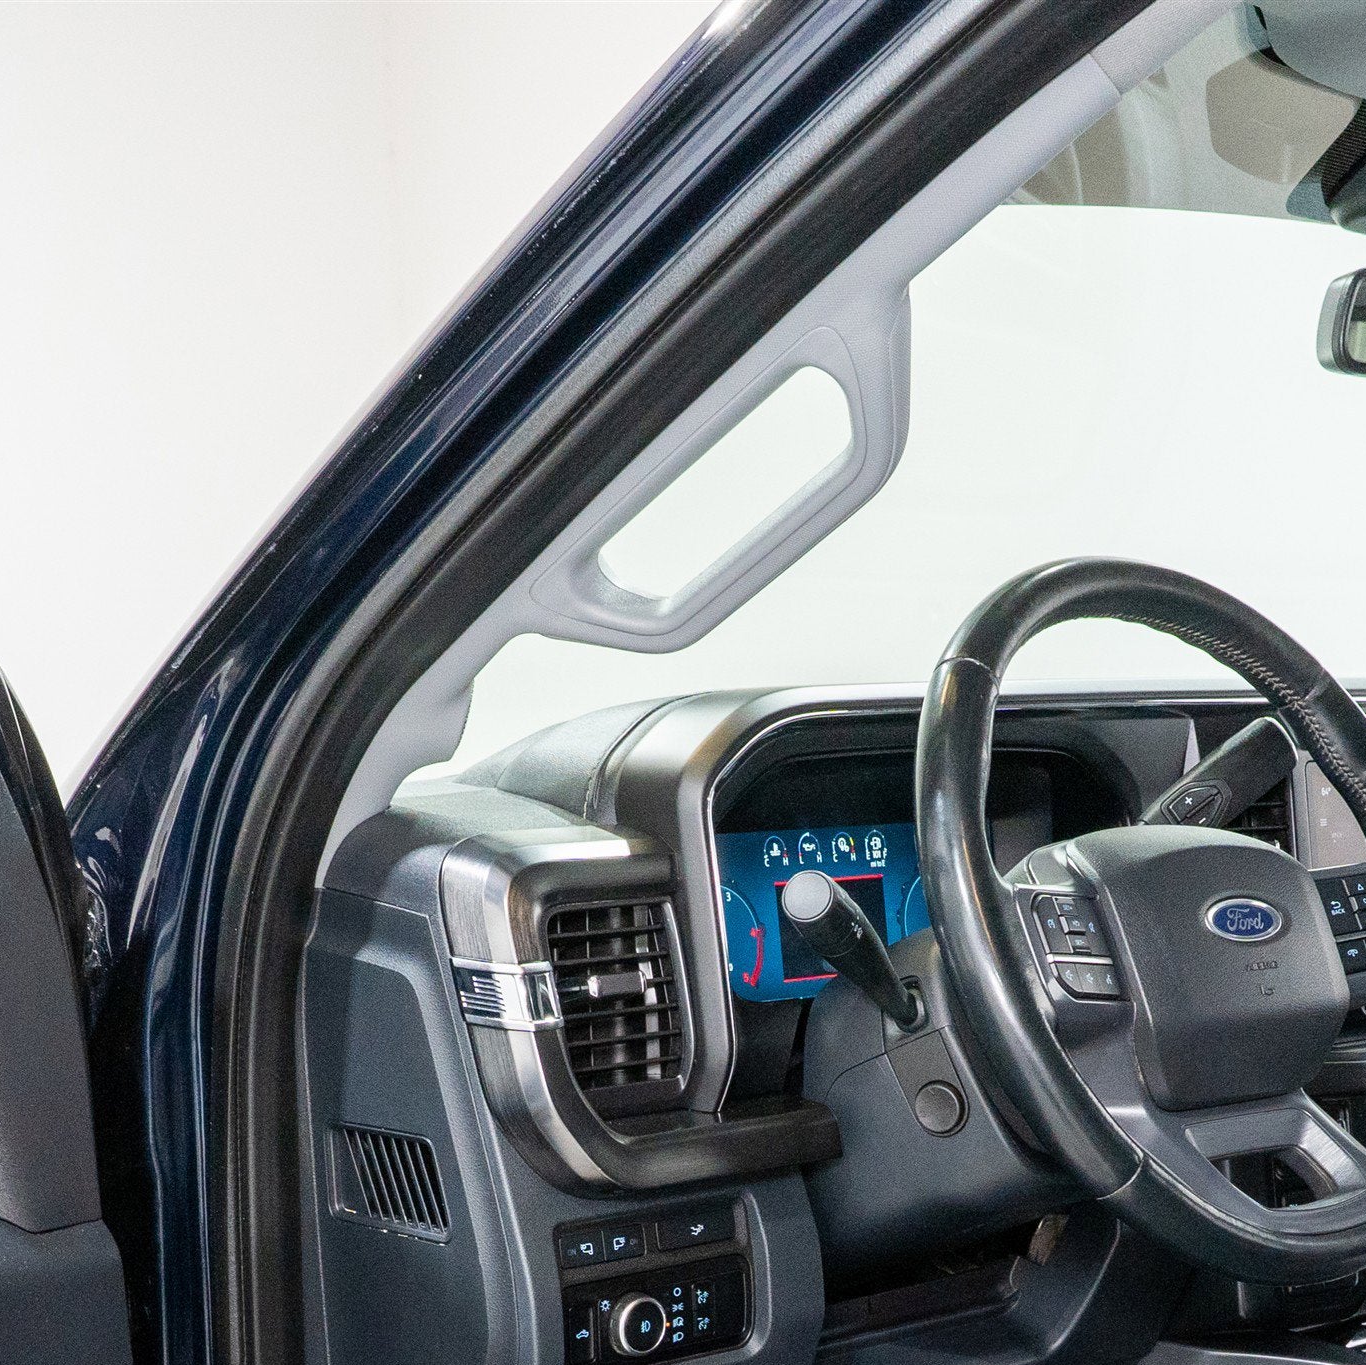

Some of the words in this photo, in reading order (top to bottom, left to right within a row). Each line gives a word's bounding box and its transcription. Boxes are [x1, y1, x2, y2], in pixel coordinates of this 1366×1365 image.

[726, 892, 732, 901] 3
[1331, 908, 1346, 916] BACK
[1226, 908, 1265, 931] Ford
